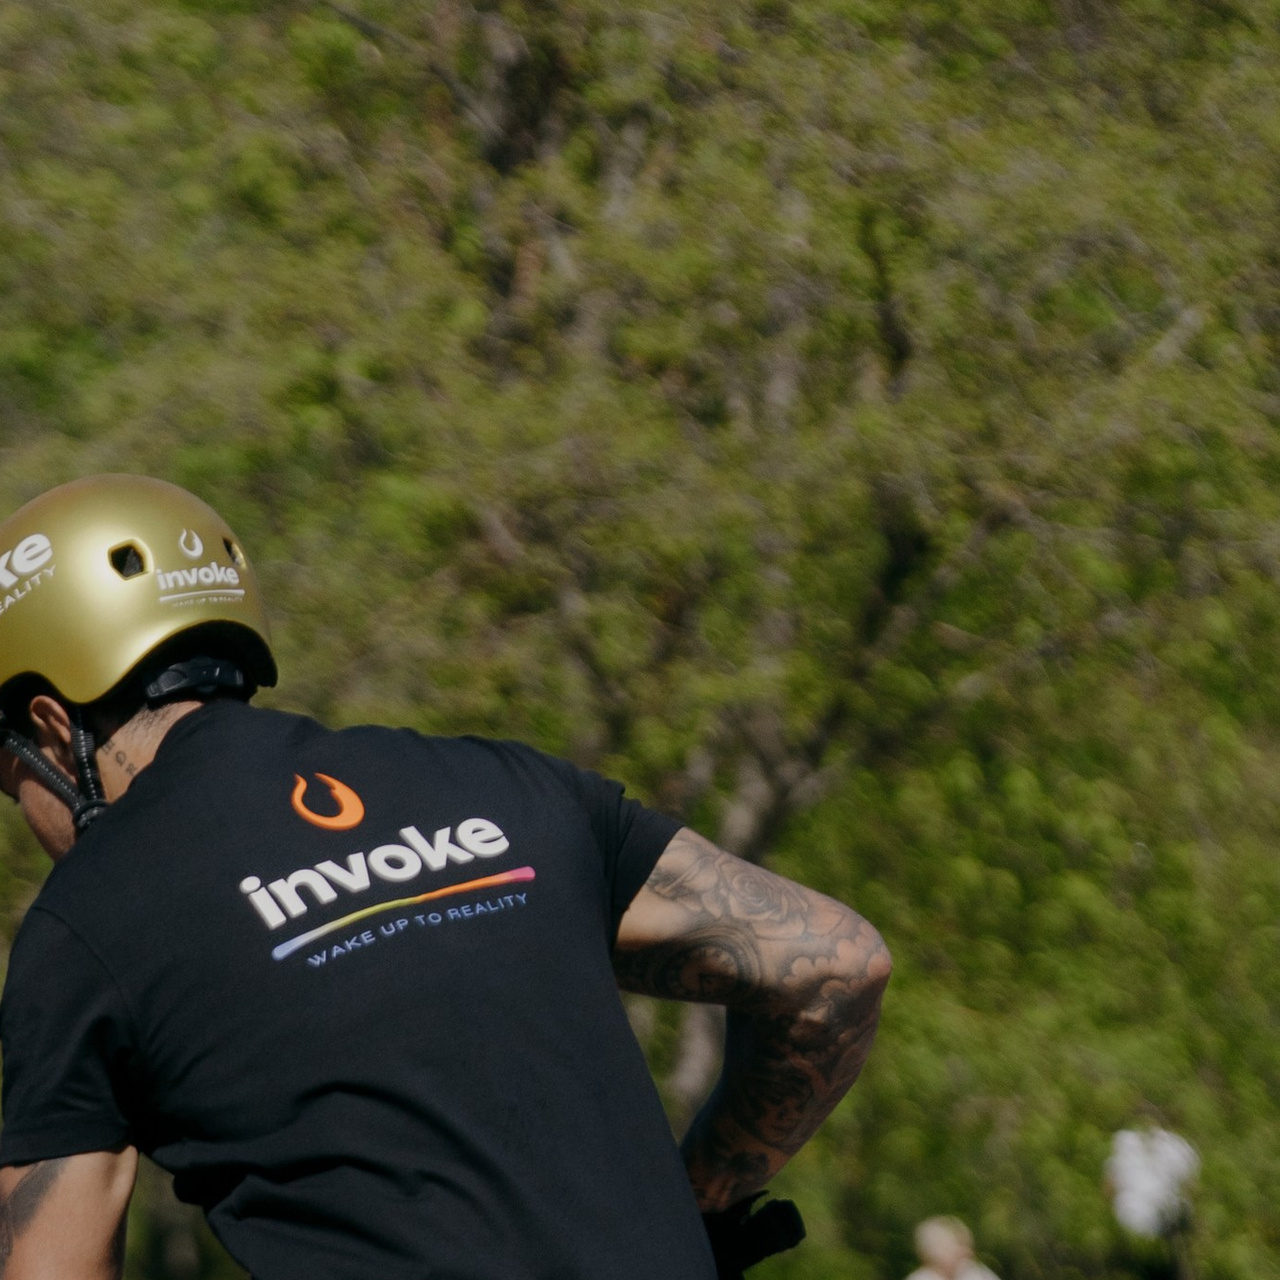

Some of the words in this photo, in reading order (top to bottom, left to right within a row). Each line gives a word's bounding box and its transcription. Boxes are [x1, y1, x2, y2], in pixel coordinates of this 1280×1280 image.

[155, 561, 239, 590] invoke
[239, 817, 510, 930] invoke
[307, 931, 376, 967] WAKE
[380, 918, 410, 938] UP
[415, 911, 442, 928] TO
[447, 893, 528, 922] REALITY
